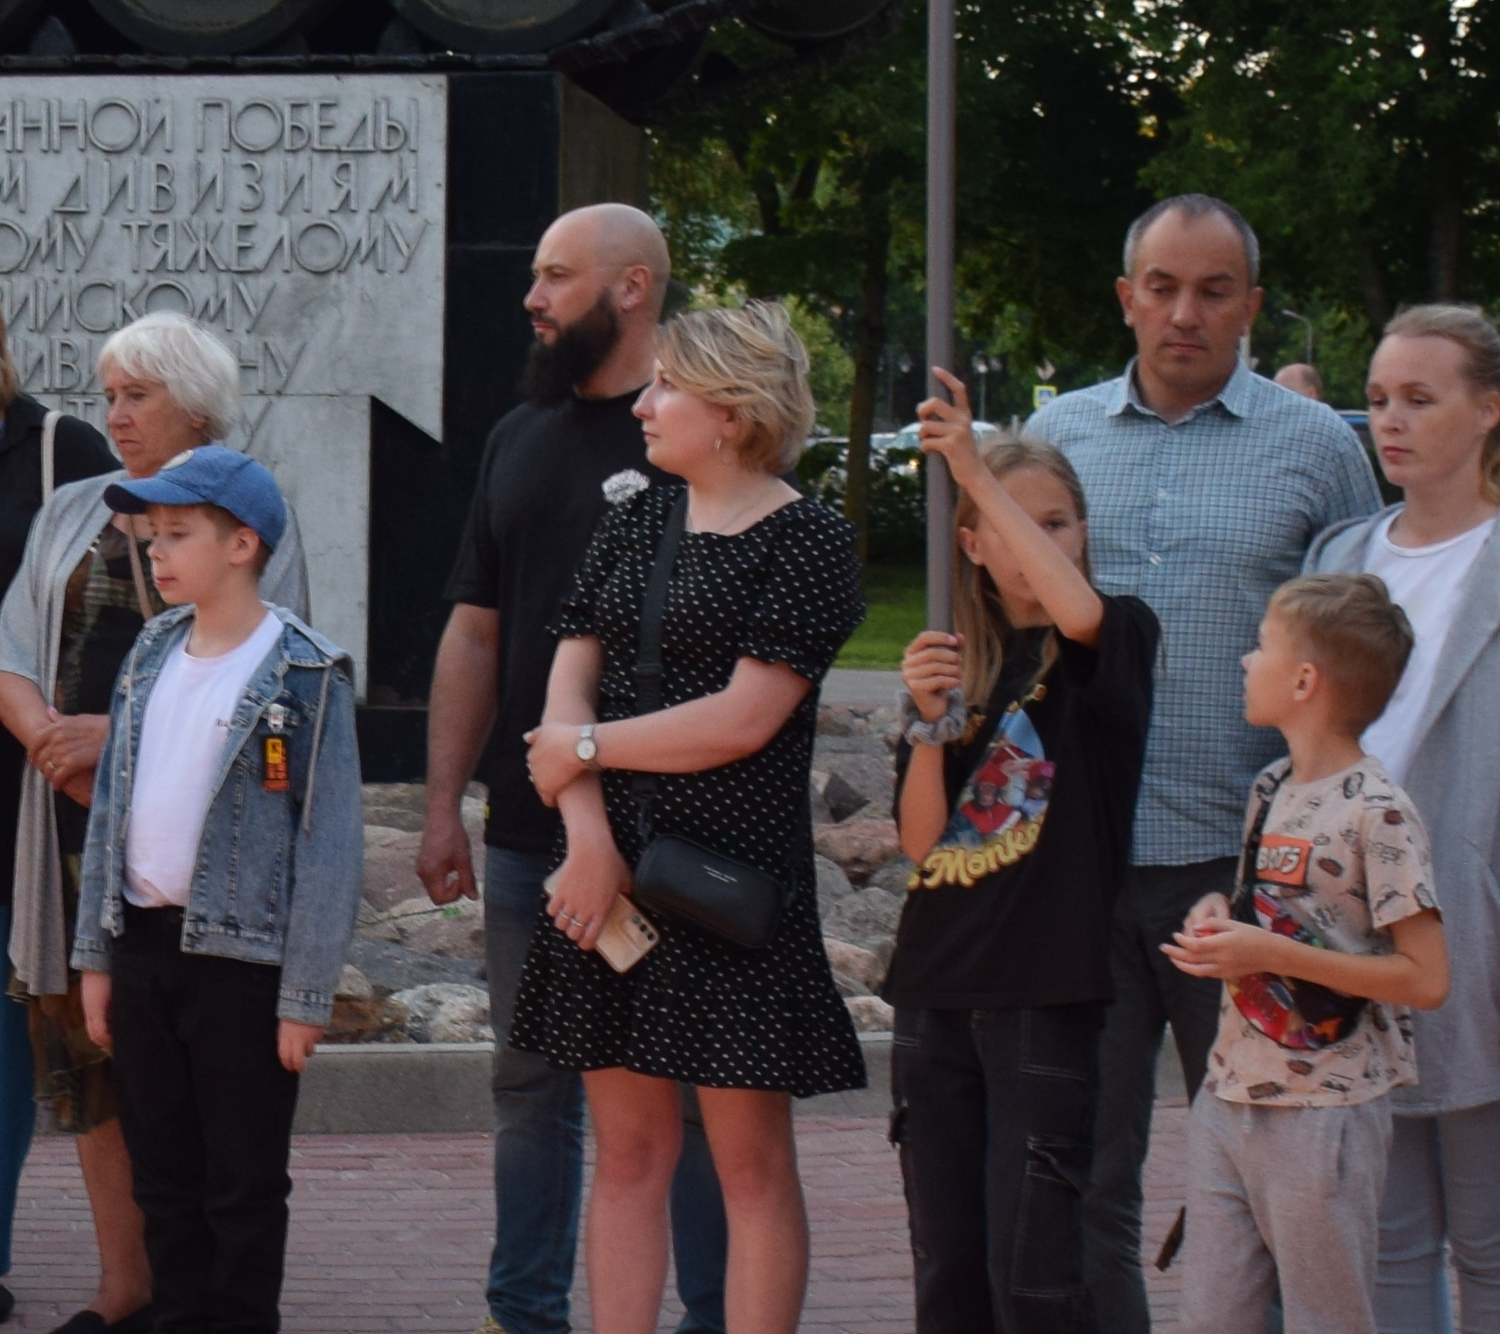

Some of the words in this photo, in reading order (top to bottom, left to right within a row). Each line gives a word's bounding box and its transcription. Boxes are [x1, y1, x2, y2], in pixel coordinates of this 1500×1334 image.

[198, 98, 419, 154] ПОБЕДЫ
[57, 160, 418, 214] ДИВИЗИЯМ
[121, 219, 428, 273] ТЯЖЕЛОМУ
